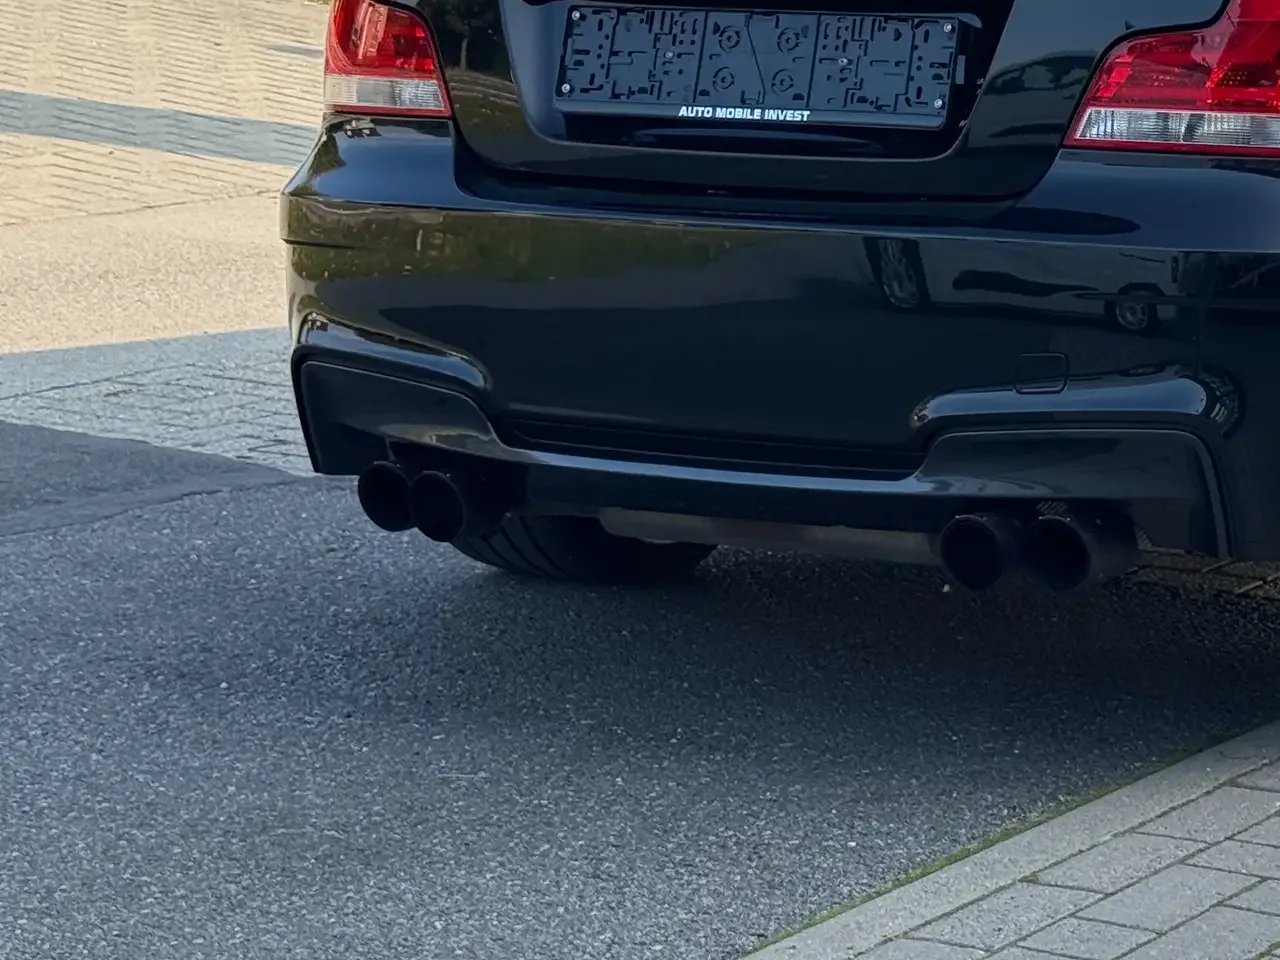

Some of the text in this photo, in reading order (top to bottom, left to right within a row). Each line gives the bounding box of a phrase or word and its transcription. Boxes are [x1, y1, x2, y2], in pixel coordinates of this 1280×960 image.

[678, 106, 811, 121] AUTO MOBILE INVEST
